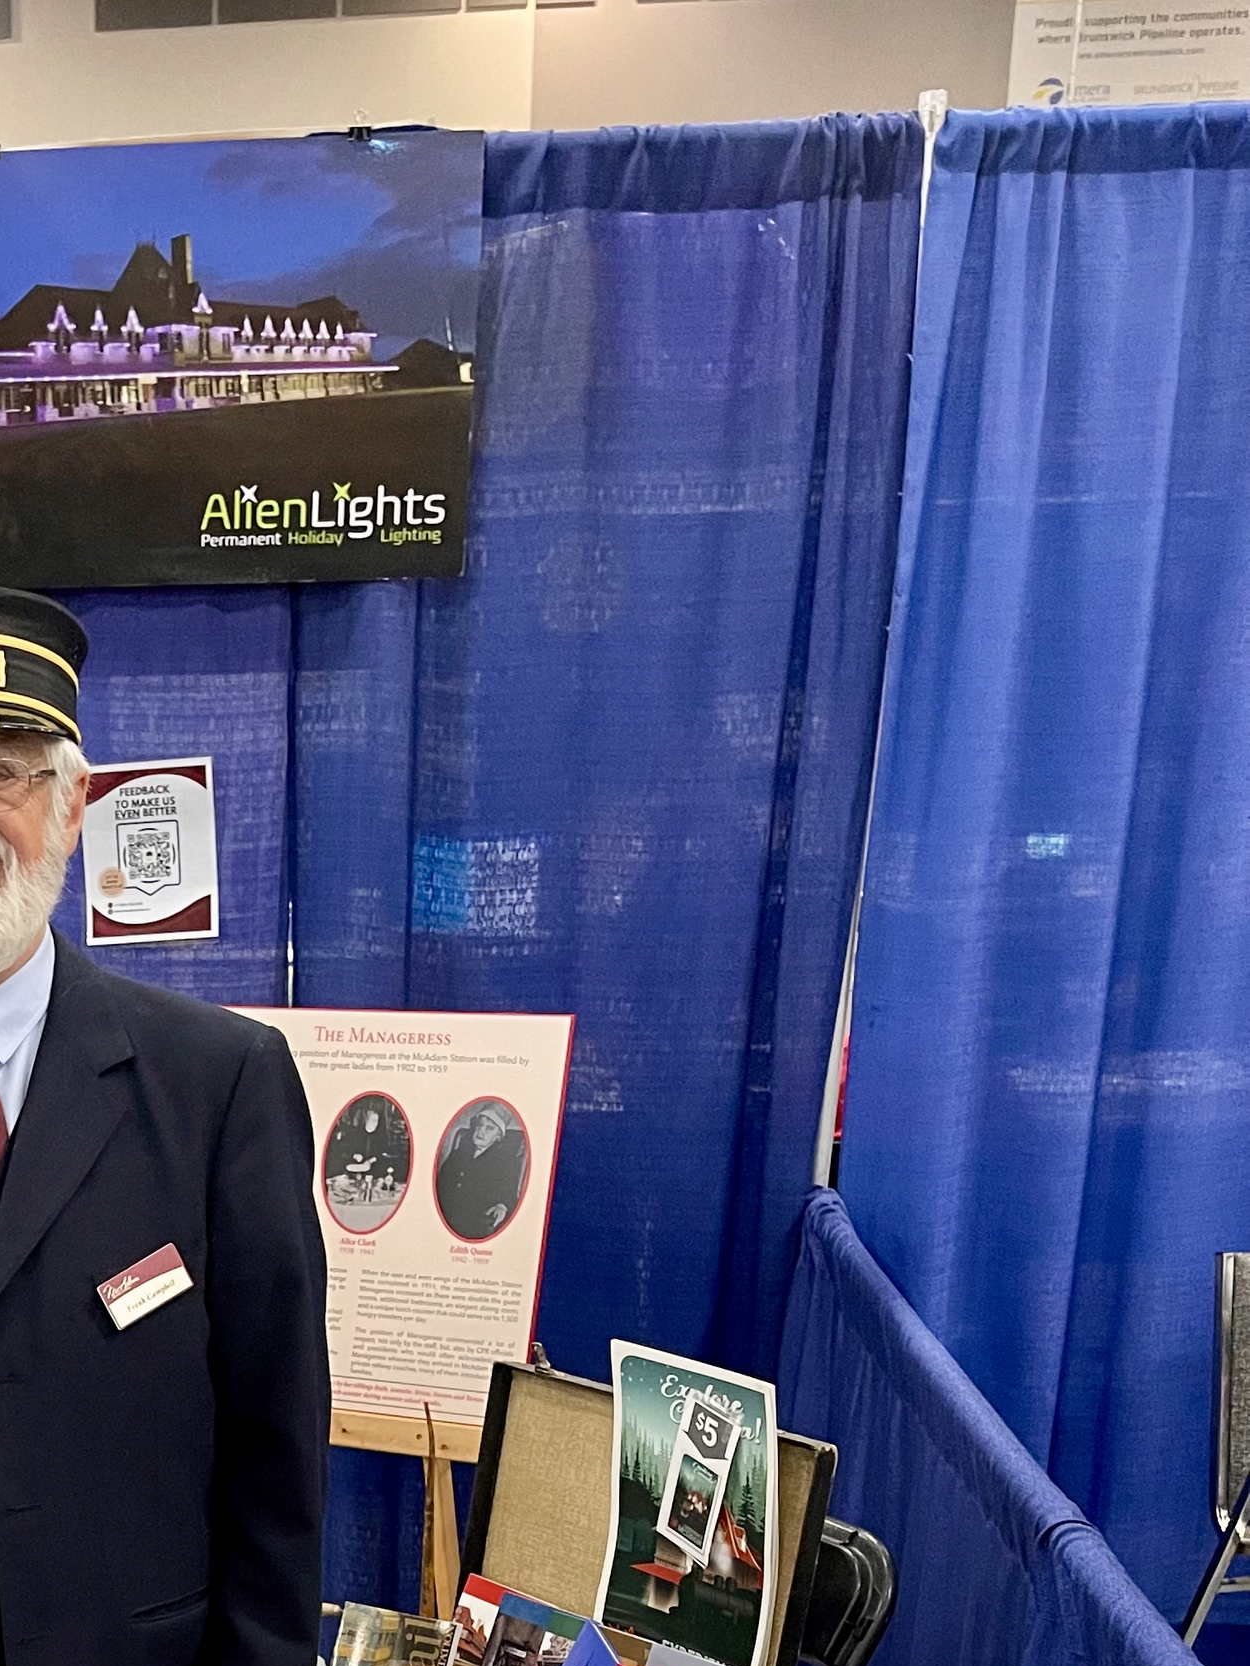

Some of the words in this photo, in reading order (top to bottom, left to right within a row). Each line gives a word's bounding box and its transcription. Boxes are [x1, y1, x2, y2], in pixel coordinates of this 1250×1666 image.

[1151, 13, 1169, 23] the
[1174, 9, 1249, 22] communities
[200, 482, 446, 538] AlienLights
[200, 532, 282, 547] Permanent
[287, 530, 344, 548] Holiday
[380, 528, 442, 545] Lighting
[119, 785, 170, 797] FEEDBACK
[115, 799, 129, 809] TO
[131, 798, 160, 808] MAKE
[162, 796, 176, 806] US
[115, 810, 140, 820] EVEN
[142, 807, 177, 817] BETTER
[309, 1061, 328, 1069] three
[330, 1062, 350, 1071] great
[352, 1061, 374, 1070] ladies
[376, 1063, 394, 1071] from
[397, 1063, 415, 1072] 1902
[412, 1053, 448, 1062] McAdam
[496, 1055, 517, 1065] filled
[518, 1056, 529, 1067] by
[695, 1411, 719, 1447] $5
